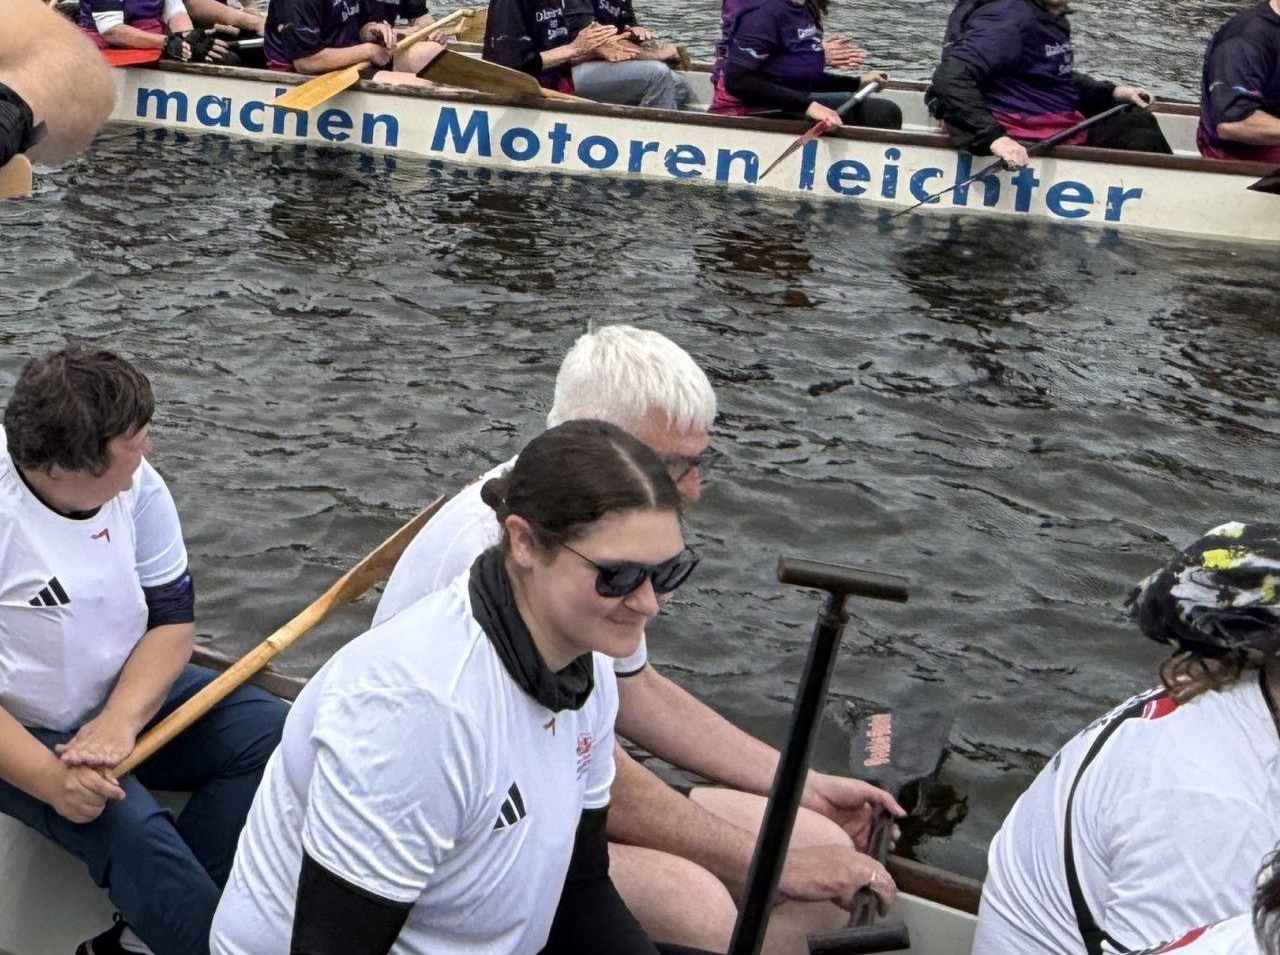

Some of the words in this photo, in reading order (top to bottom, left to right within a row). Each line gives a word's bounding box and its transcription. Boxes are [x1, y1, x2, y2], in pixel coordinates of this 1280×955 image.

[136, 86, 400, 147] machen
[430, 106, 760, 185] Motoren
[799, 139, 1144, 222] leichter
